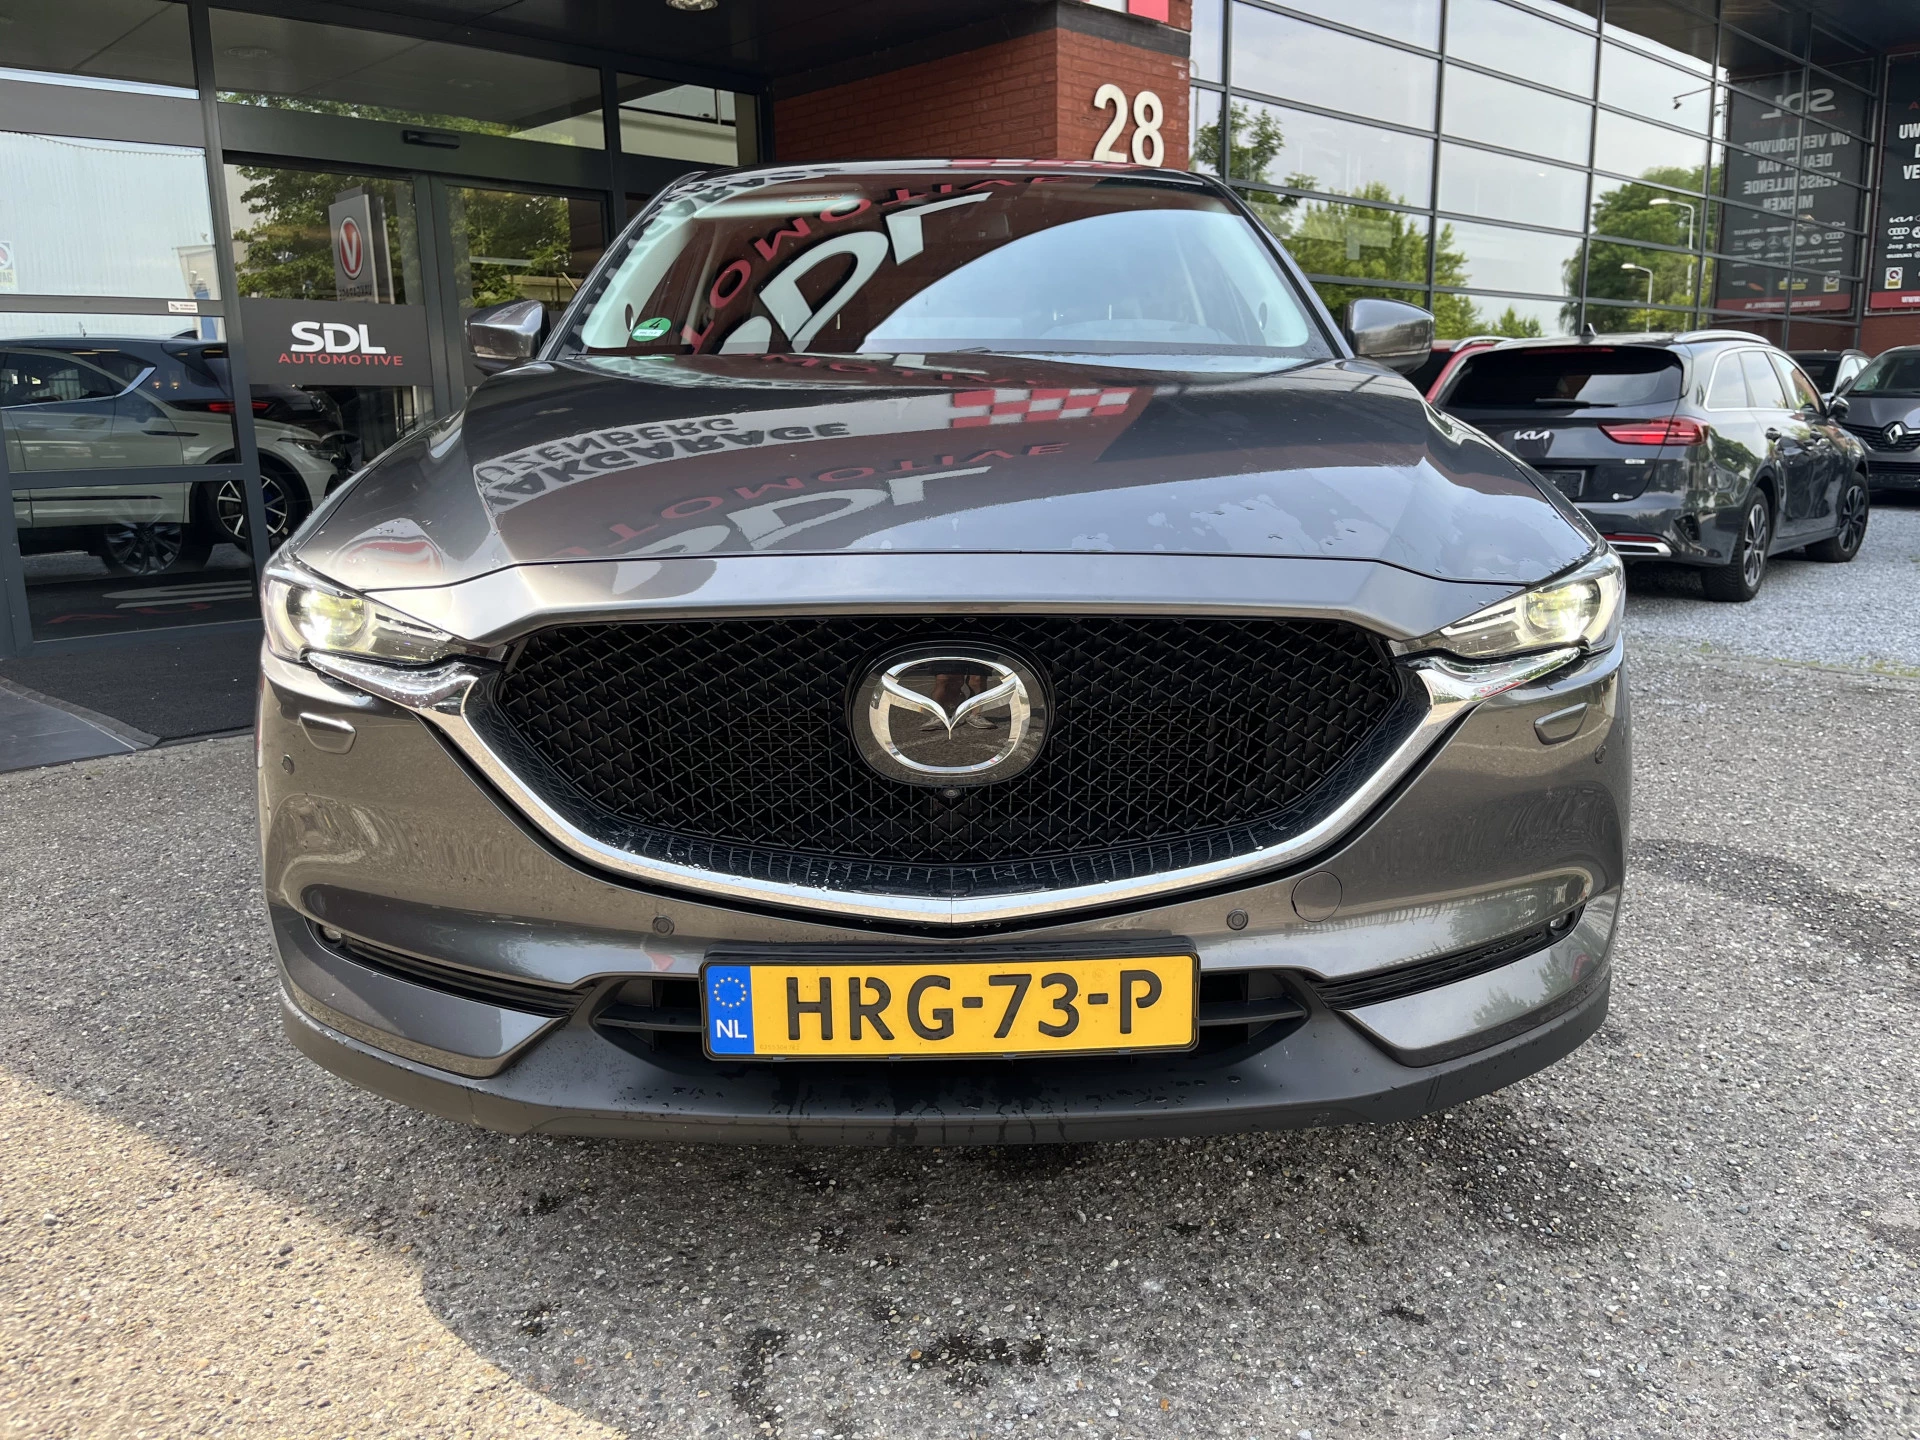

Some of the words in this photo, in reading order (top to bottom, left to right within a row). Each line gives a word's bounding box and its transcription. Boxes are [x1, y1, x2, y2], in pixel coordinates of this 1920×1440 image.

[1093, 84, 1164, 167] 28
[649, 318, 662, 330] 4
[290, 321, 387, 355] SDL
[278, 353, 404, 366] AUTOMOTIVE
[785, 969, 1163, 1041] HRG-73-P
[716, 1019, 748, 1039] NL
